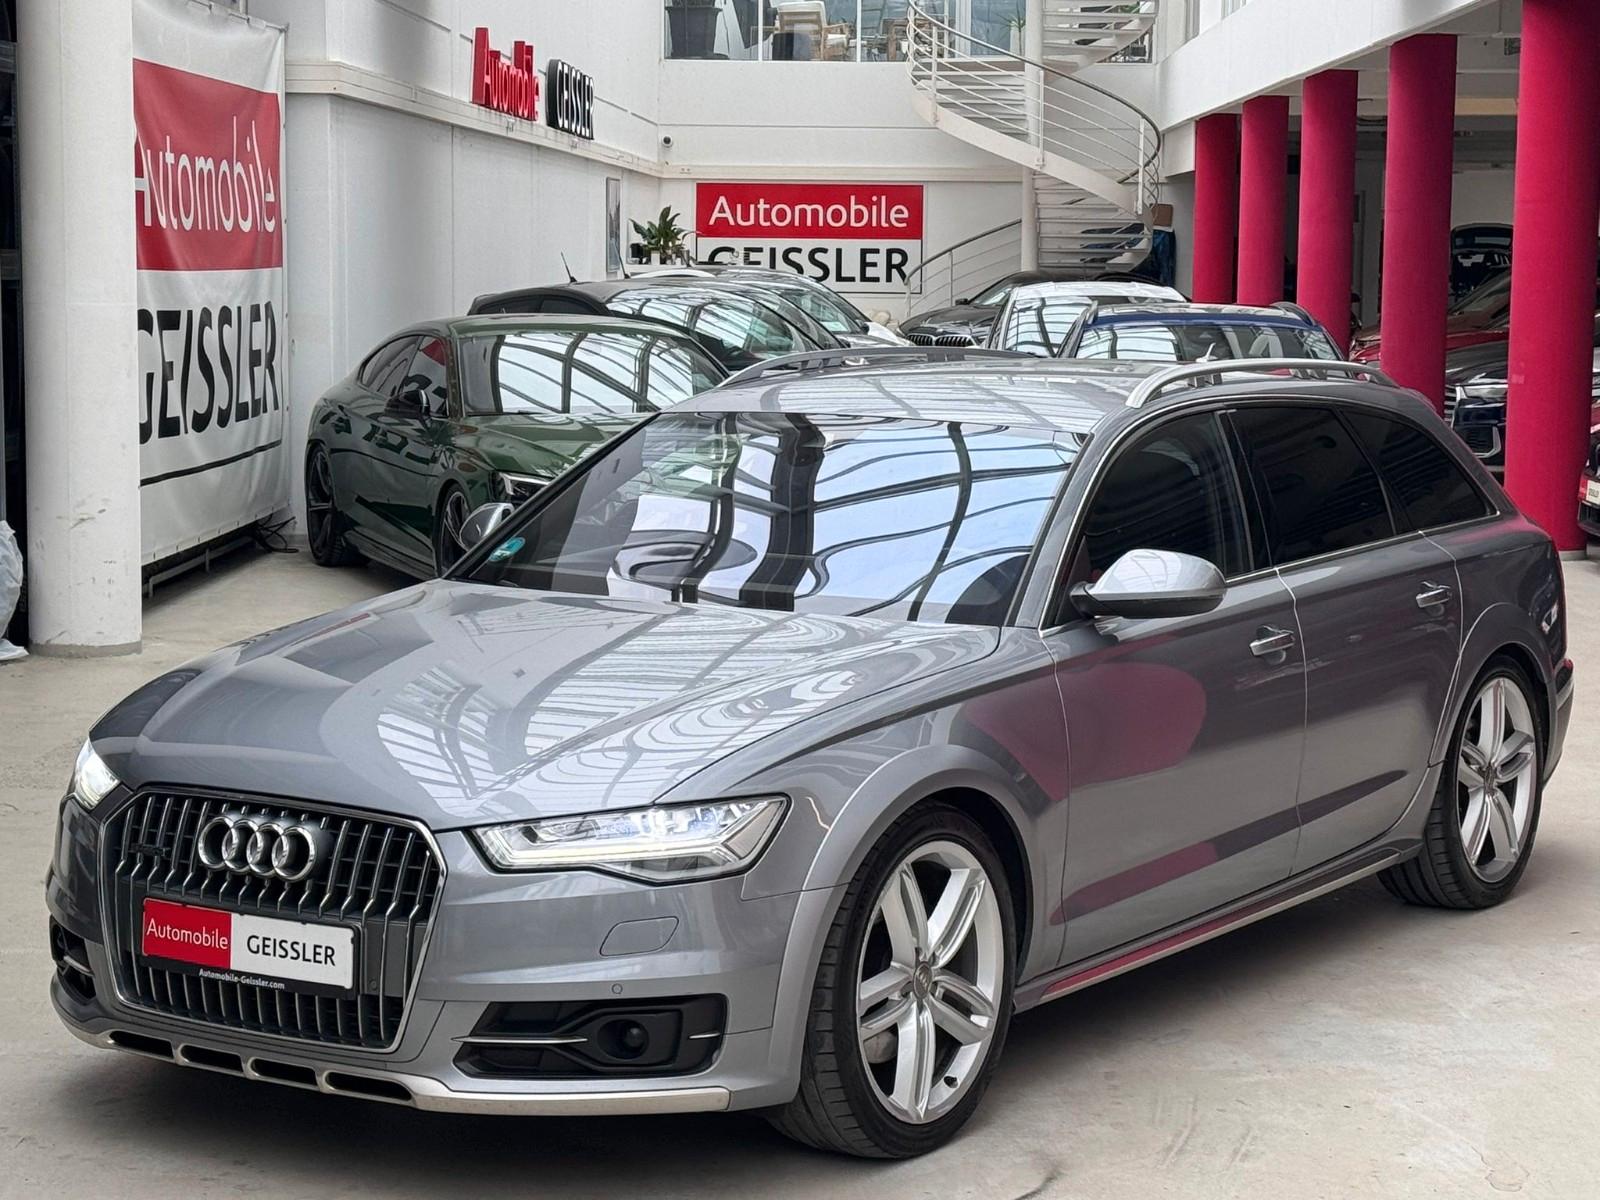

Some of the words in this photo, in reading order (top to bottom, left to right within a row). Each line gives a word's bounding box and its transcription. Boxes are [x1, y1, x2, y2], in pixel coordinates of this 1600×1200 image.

[548, 59, 594, 140] GEISSLER
[708, 195, 909, 228] Automobile
[146, 918, 229, 950] Automobile
[246, 934, 336, 967] GEISSLER
[198, 968, 285, 990] Automobile-Geissler.com
